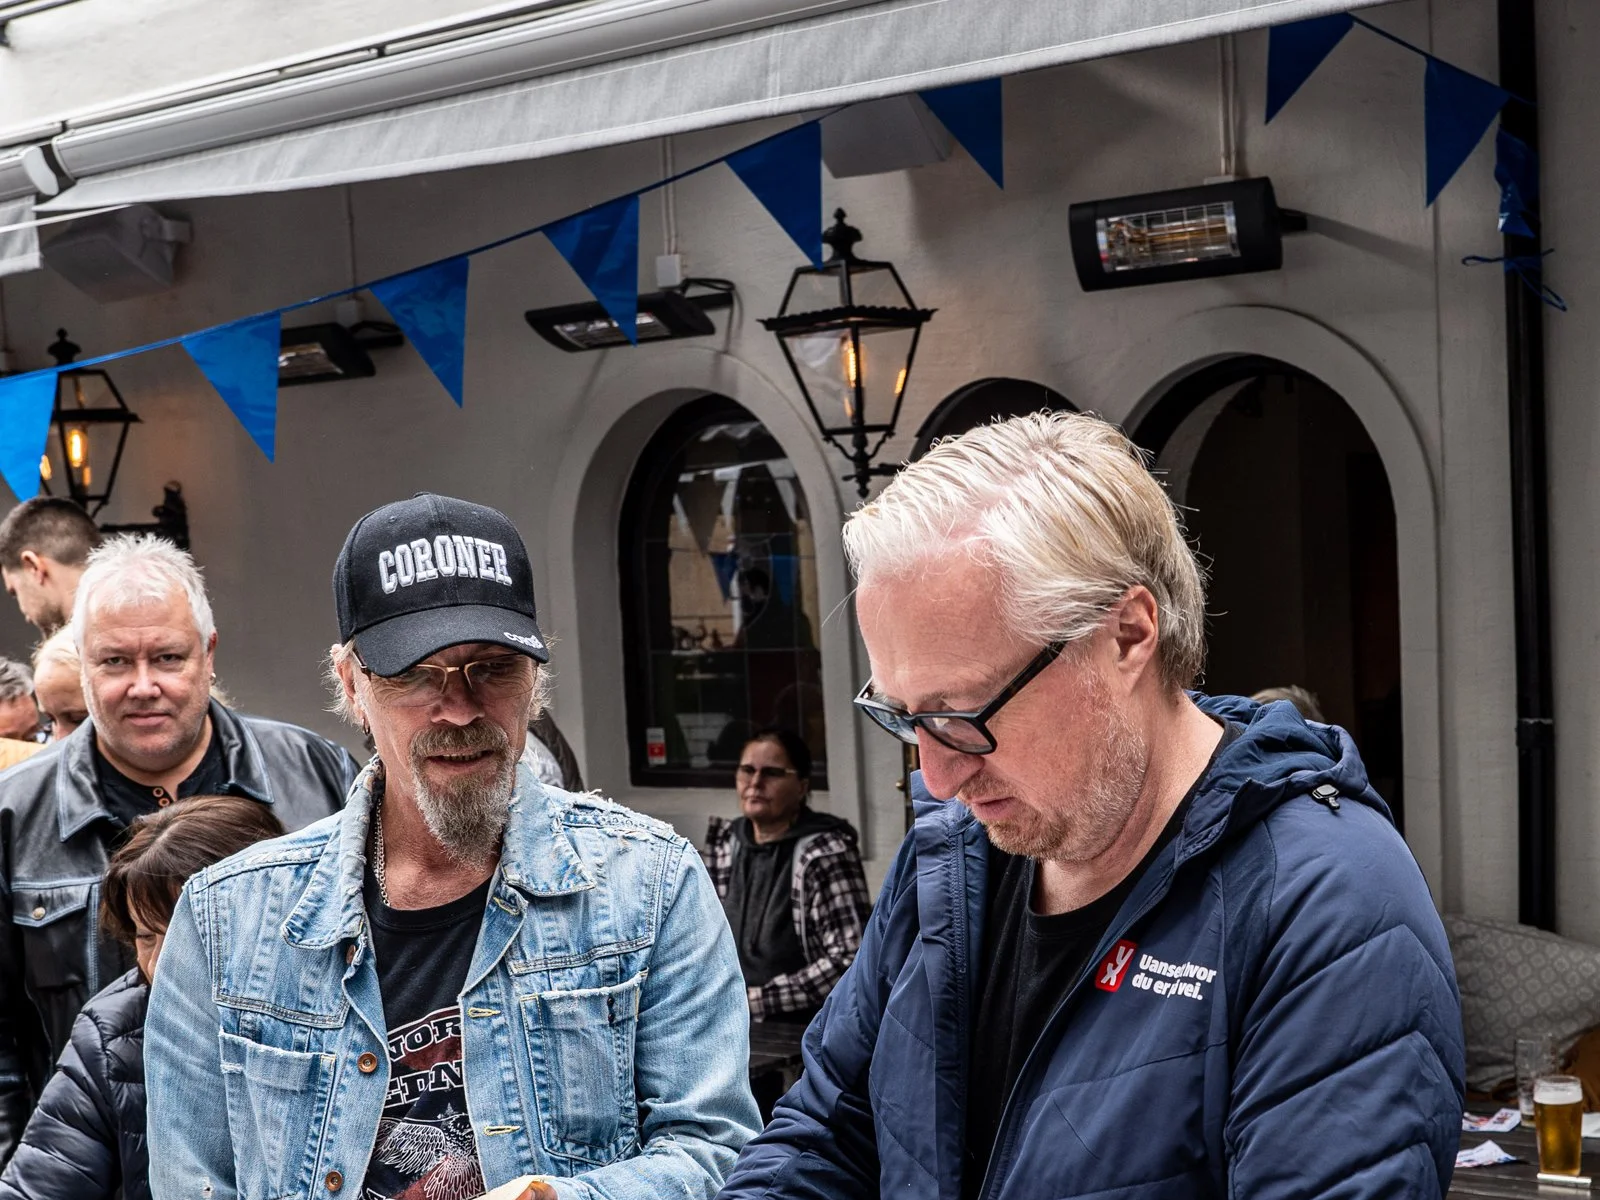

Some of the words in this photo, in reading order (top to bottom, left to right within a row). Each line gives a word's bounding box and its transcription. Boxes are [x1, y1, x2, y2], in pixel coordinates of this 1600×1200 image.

[378, 534, 513, 595] CORONER
[1131, 972, 1153, 990] du
[1153, 979, 1171, 995] er
[1177, 981, 1203, 1001] vei.
